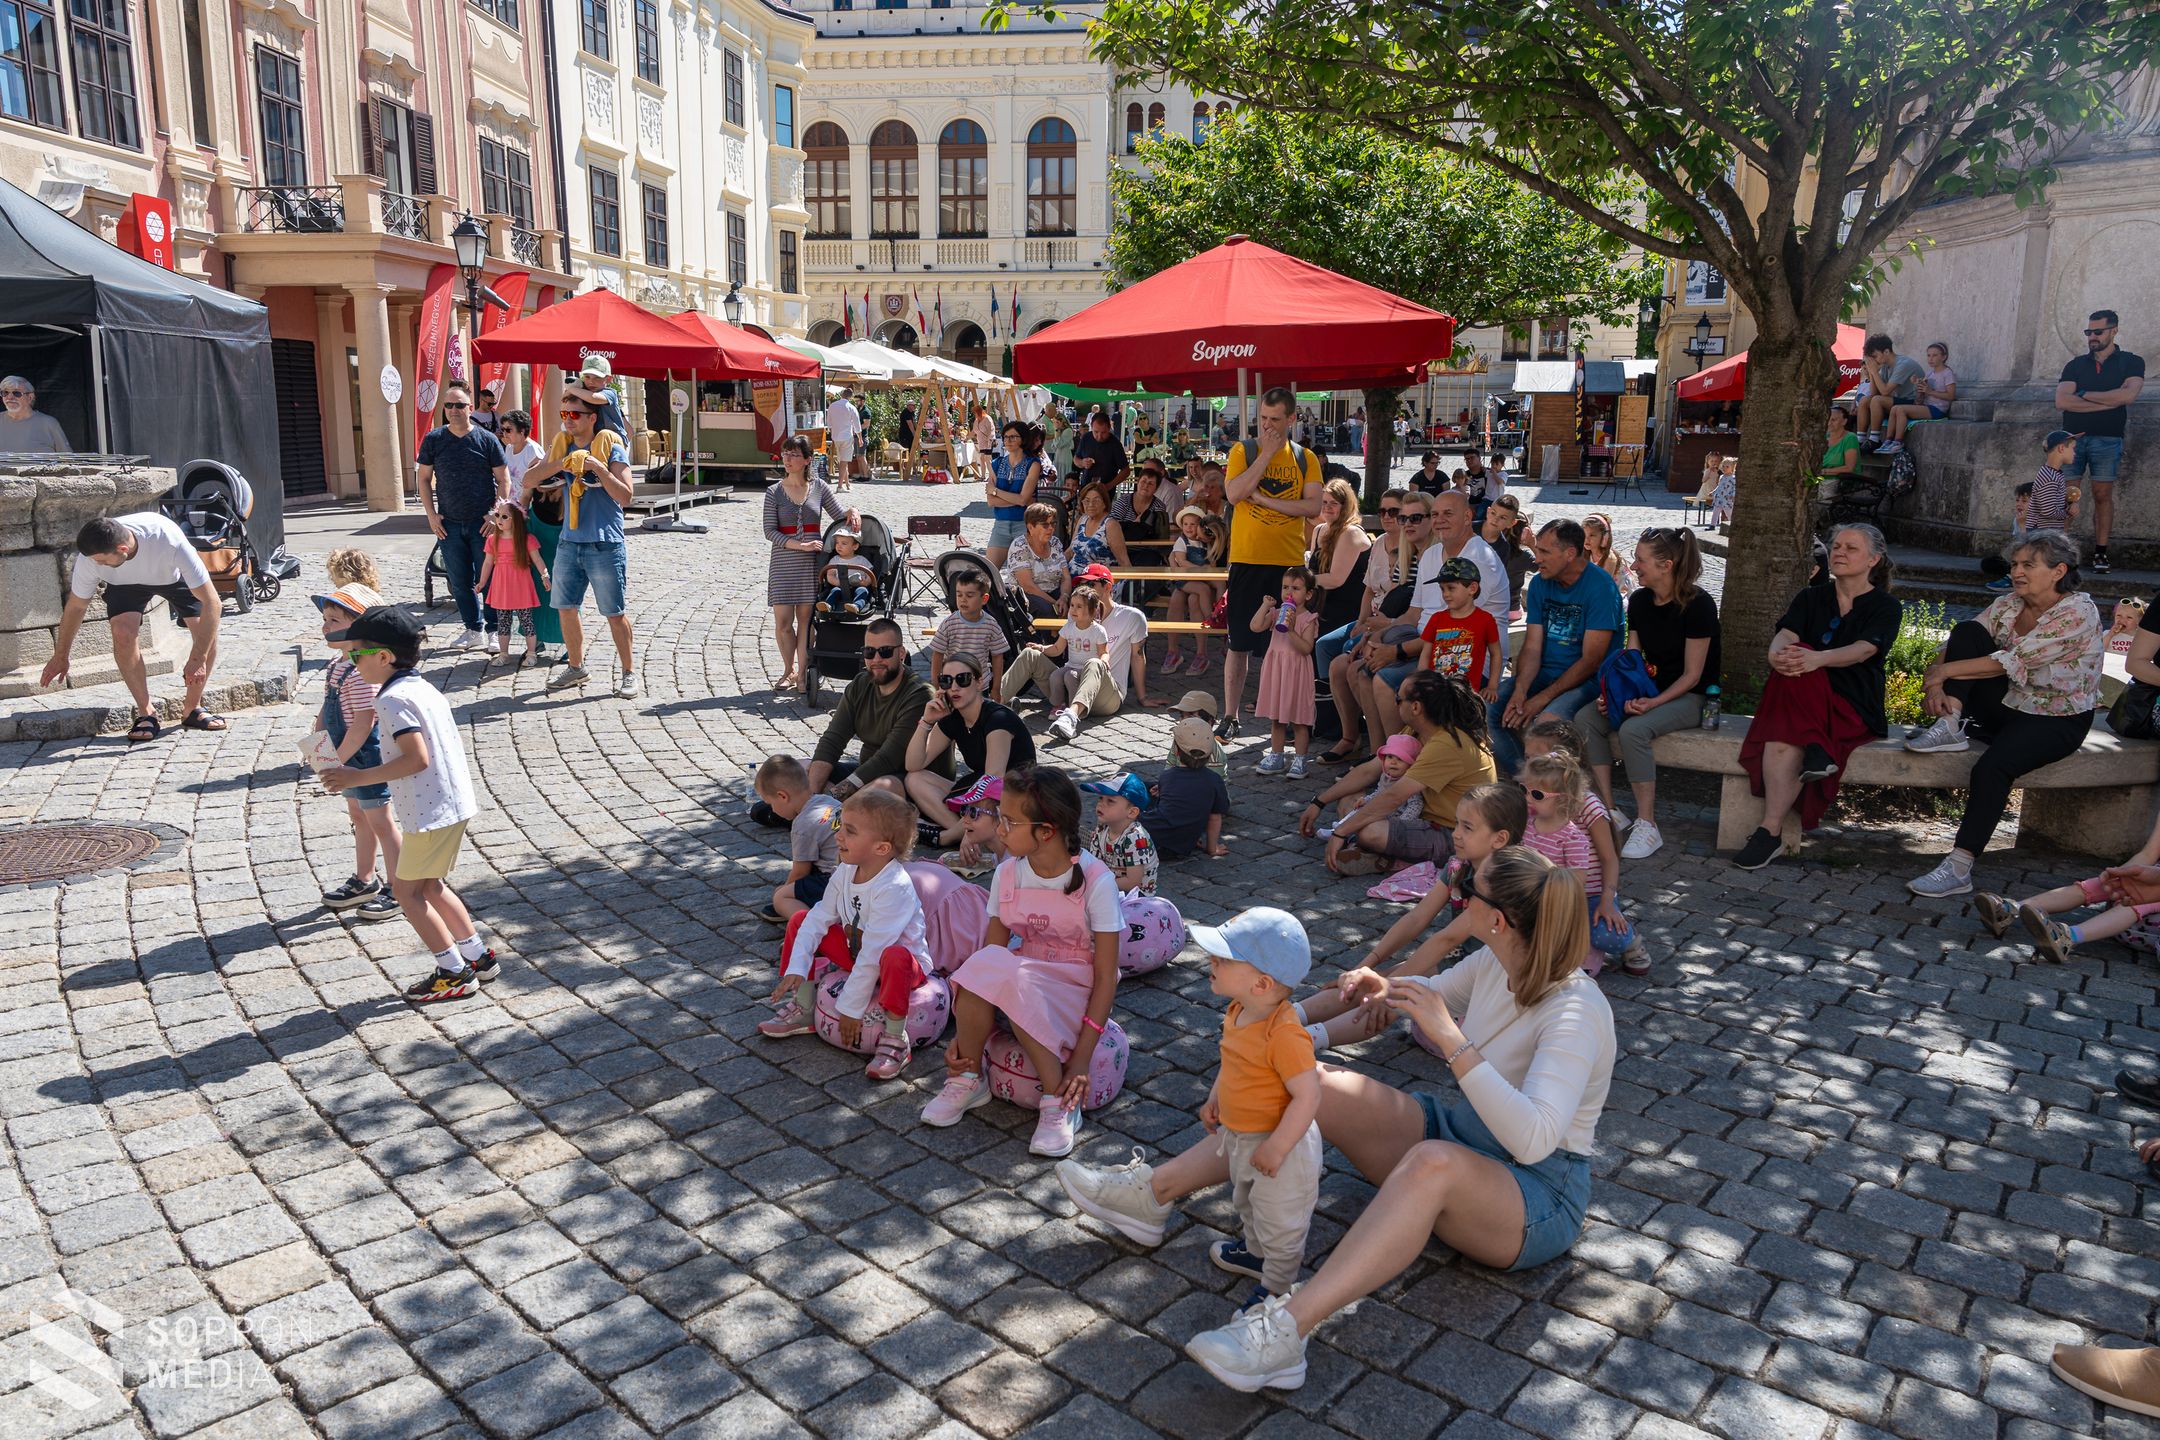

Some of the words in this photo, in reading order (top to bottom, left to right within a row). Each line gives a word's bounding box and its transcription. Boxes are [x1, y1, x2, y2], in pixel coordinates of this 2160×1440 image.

[1192, 340, 1257, 366] Sopron
[1839, 364, 1862, 379] Sopr
[1452, 645, 1471, 653] UP!
